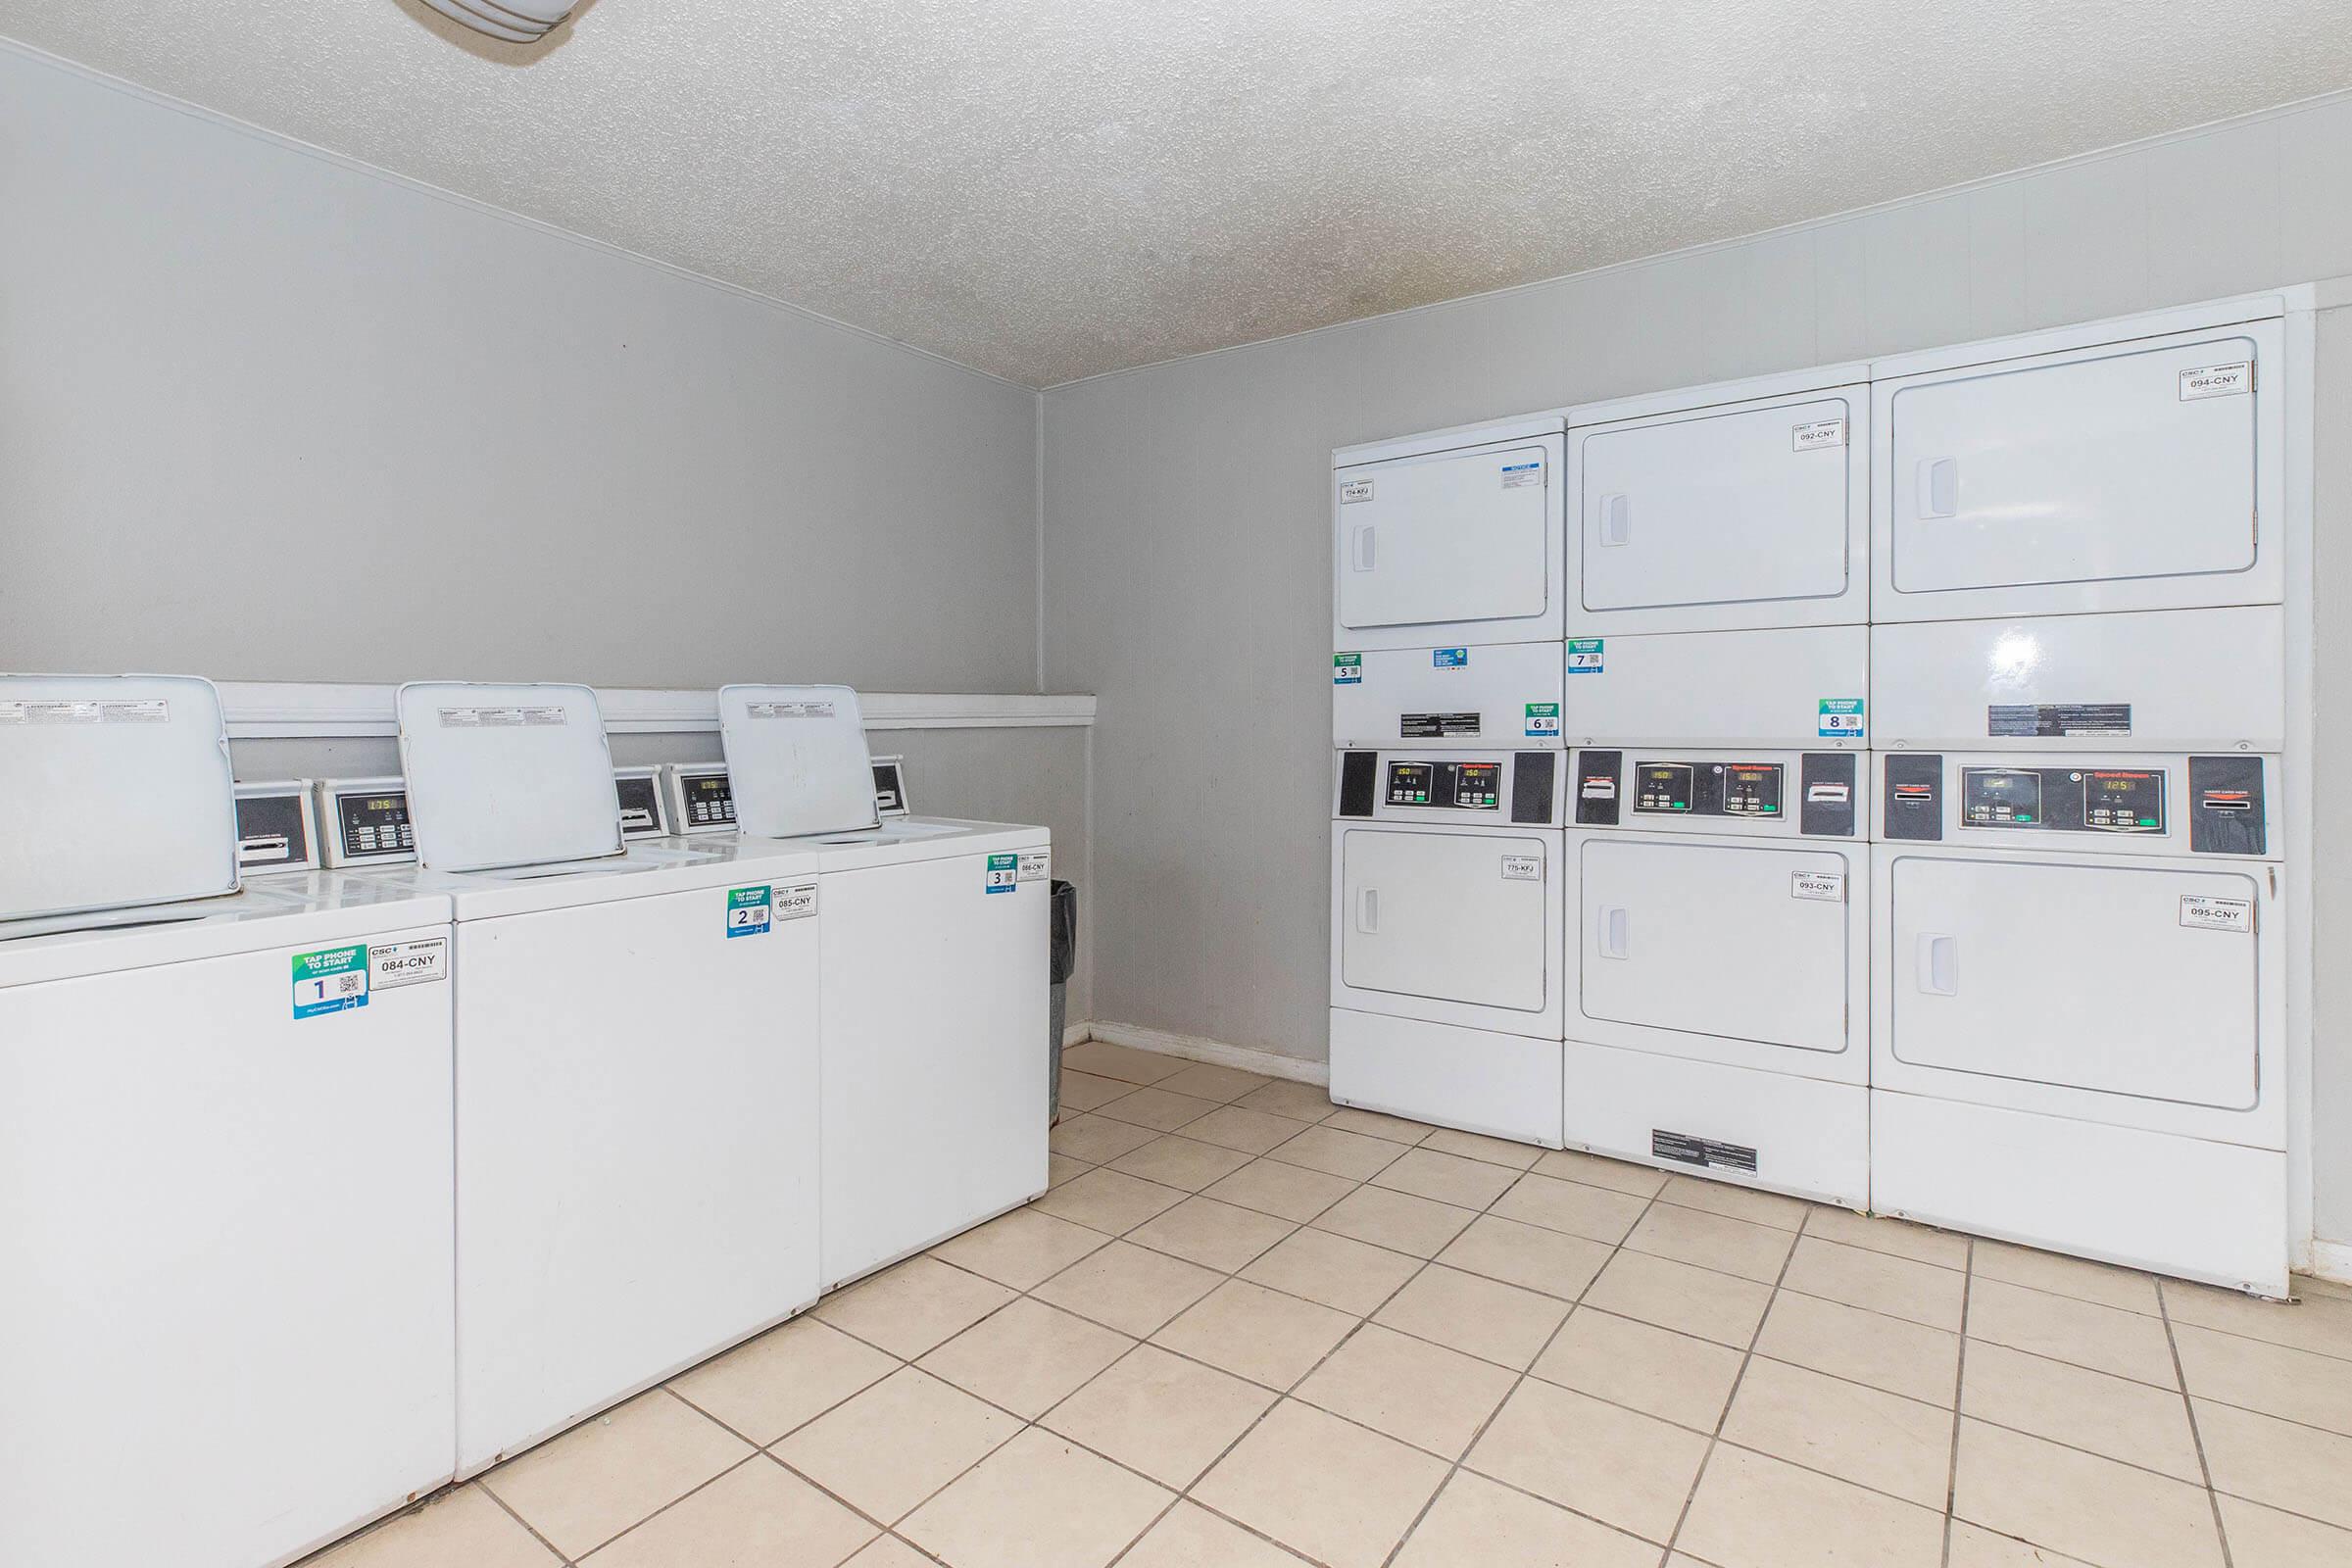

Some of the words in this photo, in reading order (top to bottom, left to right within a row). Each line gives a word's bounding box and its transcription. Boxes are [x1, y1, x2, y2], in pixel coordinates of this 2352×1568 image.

[2190, 374, 2238, 388] 094-CNY
[1800, 430, 1836, 441] 092-CNY
[1577, 655, 1585, 665] 7
[1341, 667, 1348, 677] 5
[1534, 718, 1542, 729] 6
[1831, 716, 1839, 727] 8
[994, 872, 1001, 884] 3
[1799, 882, 1835, 891] 093-CNY
[779, 897, 811, 908] 085-CNY
[738, 910, 748, 924] 2
[2190, 907, 2239, 919] 095-CNY
[304, 955, 322, 964] TAP
[323, 949, 357, 960] PHONE
[323, 956, 354, 967] START
[381, 955, 436, 971] 084-CNY
[314, 980, 324, 999] 1
